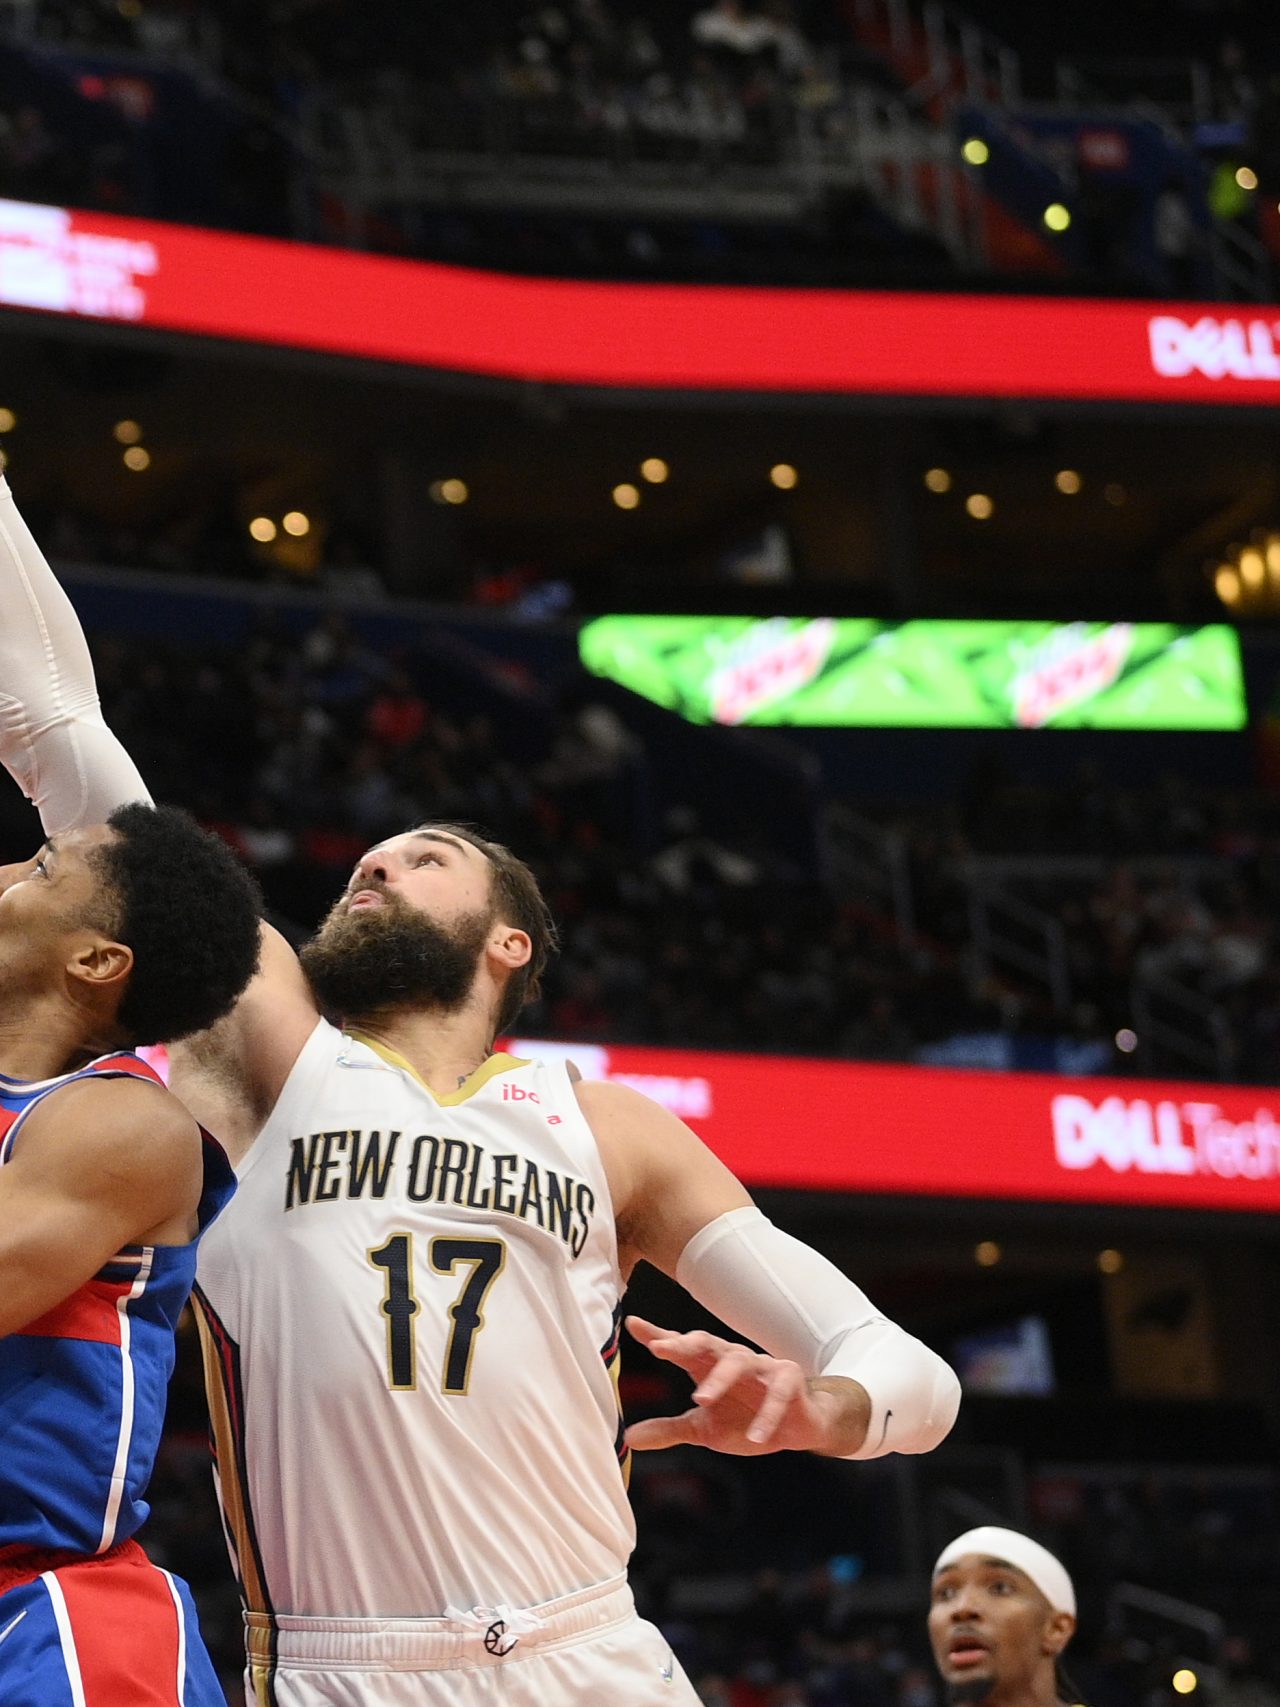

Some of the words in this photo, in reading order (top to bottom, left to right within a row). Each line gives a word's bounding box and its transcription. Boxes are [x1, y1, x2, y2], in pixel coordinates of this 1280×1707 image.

[284, 1130, 401, 1212] NEW
[407, 1134, 595, 1260] ORLEANS
[366, 1232, 507, 1396] 17
